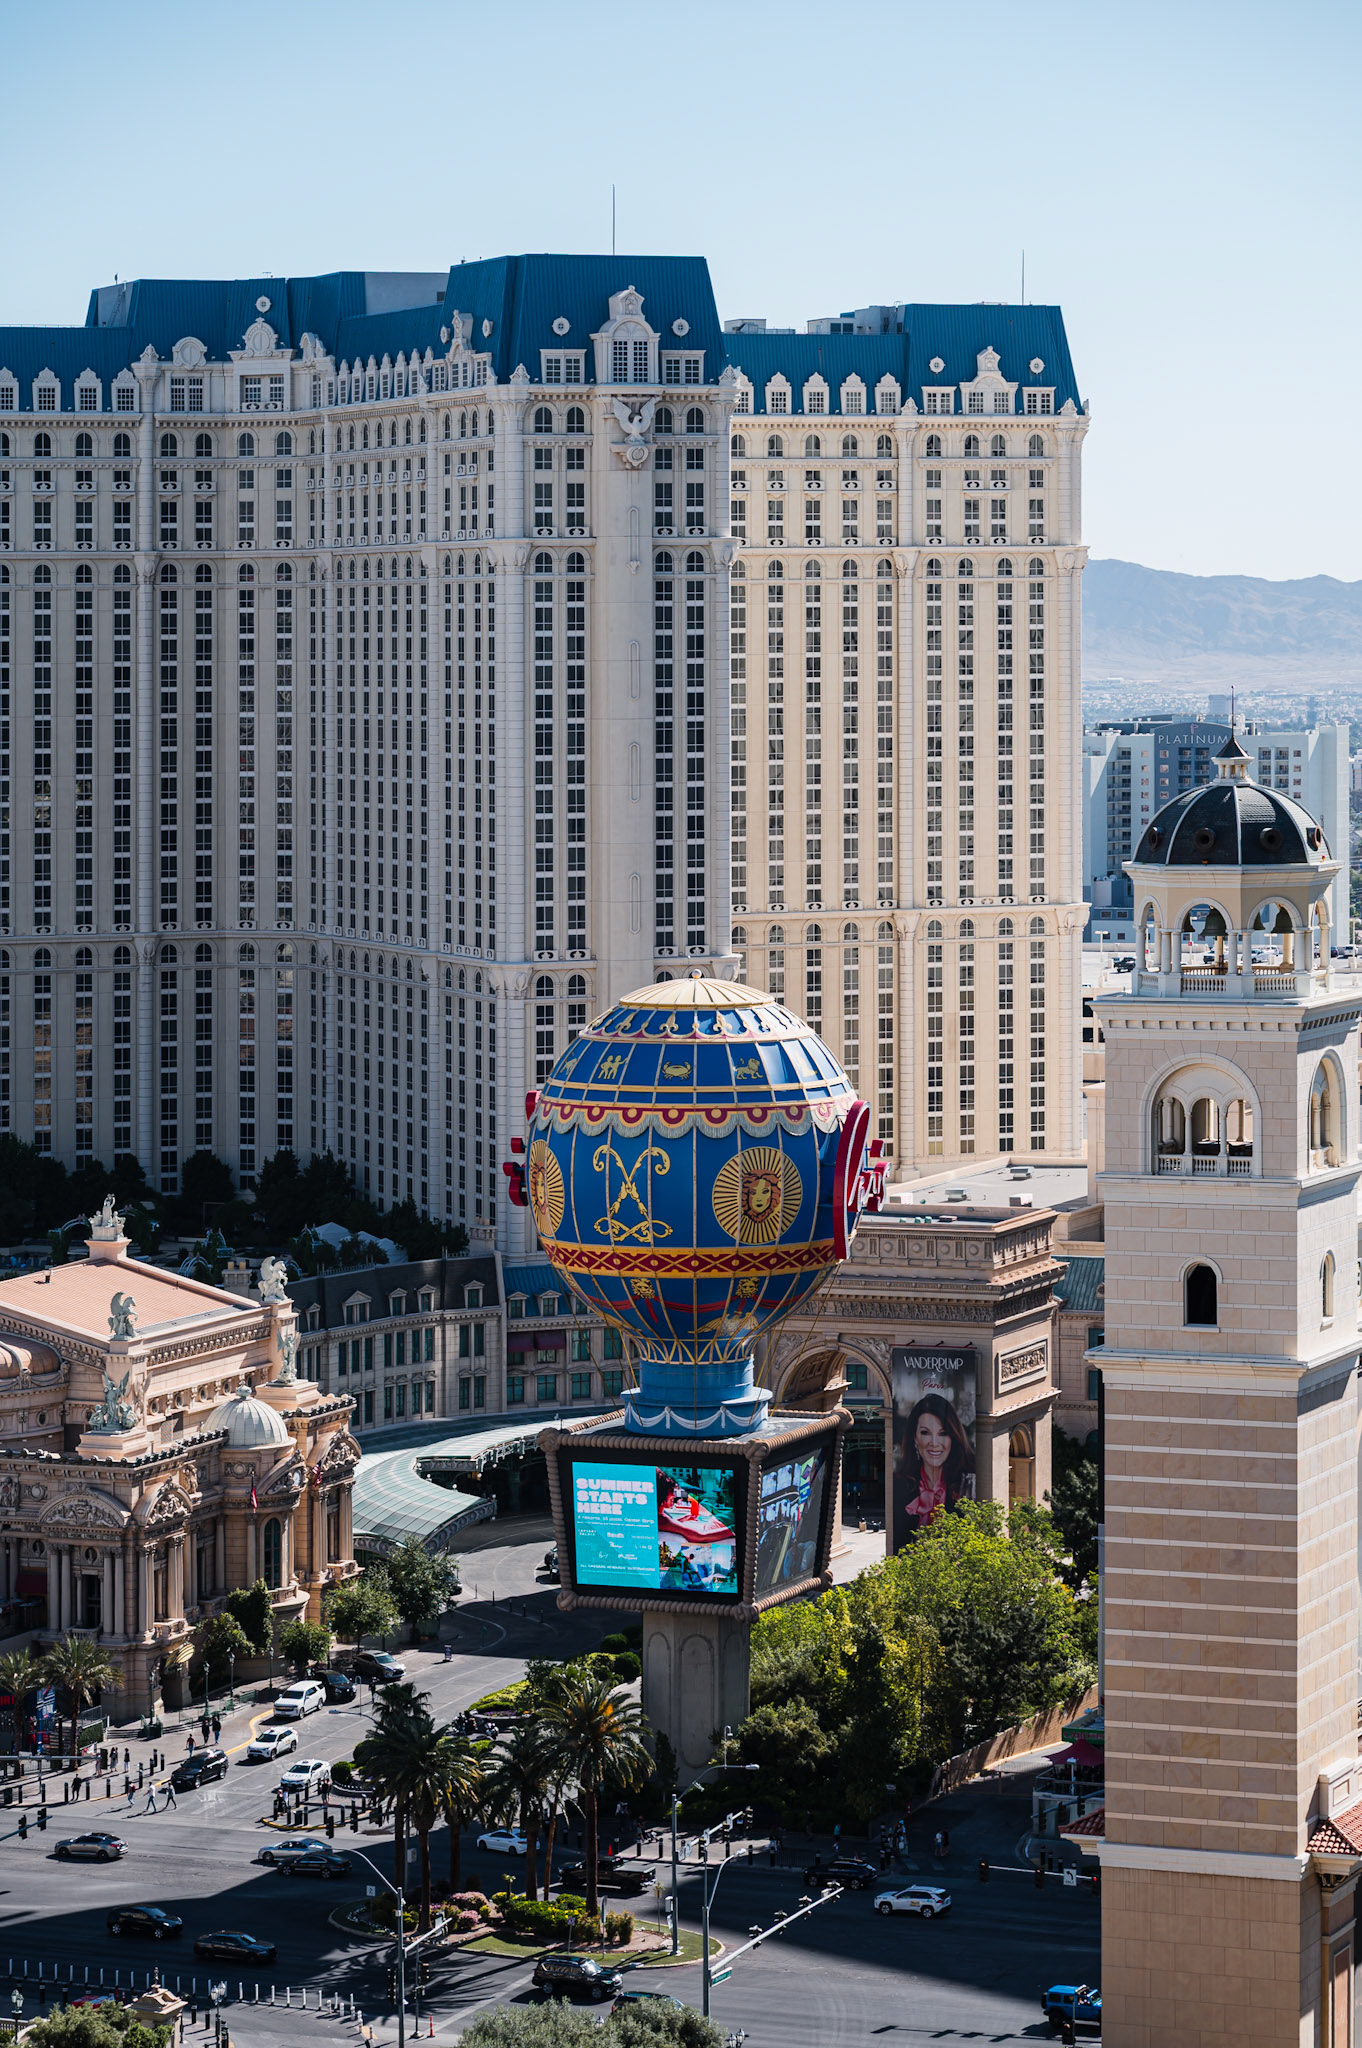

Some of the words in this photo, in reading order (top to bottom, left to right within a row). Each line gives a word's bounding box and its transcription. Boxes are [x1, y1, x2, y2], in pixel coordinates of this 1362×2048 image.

[1158, 735, 1227, 745] PLATINUM
[903, 1355, 964, 1373] VANDERPUMP
[921, 1378, 945, 1391] Paris
[576, 1478, 654, 1493] SUMMER
[576, 1490, 648, 1505] STARTS
[576, 1502, 623, 1515] HERE
